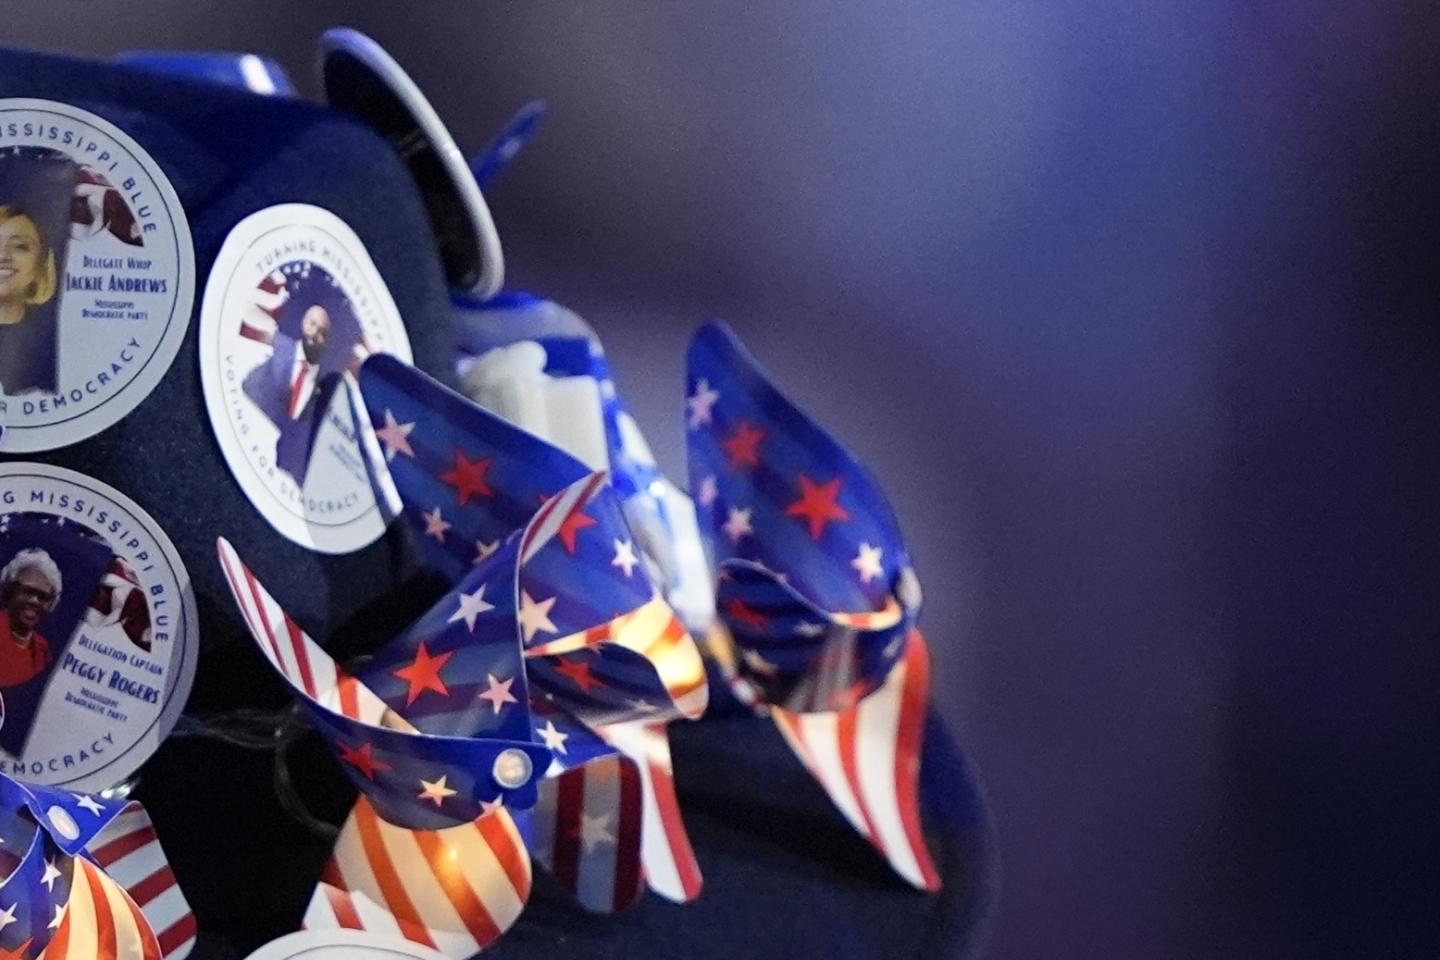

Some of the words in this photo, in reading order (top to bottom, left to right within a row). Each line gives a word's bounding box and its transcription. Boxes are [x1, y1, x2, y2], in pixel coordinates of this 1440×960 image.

[122, 177, 157, 233] BLUE
[66, 272, 102, 291] JACKIE
[108, 274, 167, 293] ANDREWS
[23, 336, 143, 415] DEMOCRACY
[31, 490, 154, 573] MISSISSIPPI
[150, 583, 169, 642] BLUE
[63, 652, 106, 684] PEGGY
[108, 670, 160, 704] ROGERS
[78, 633, 127, 662] DELEGATION
[130, 654, 163, 676] CAPTAIN
